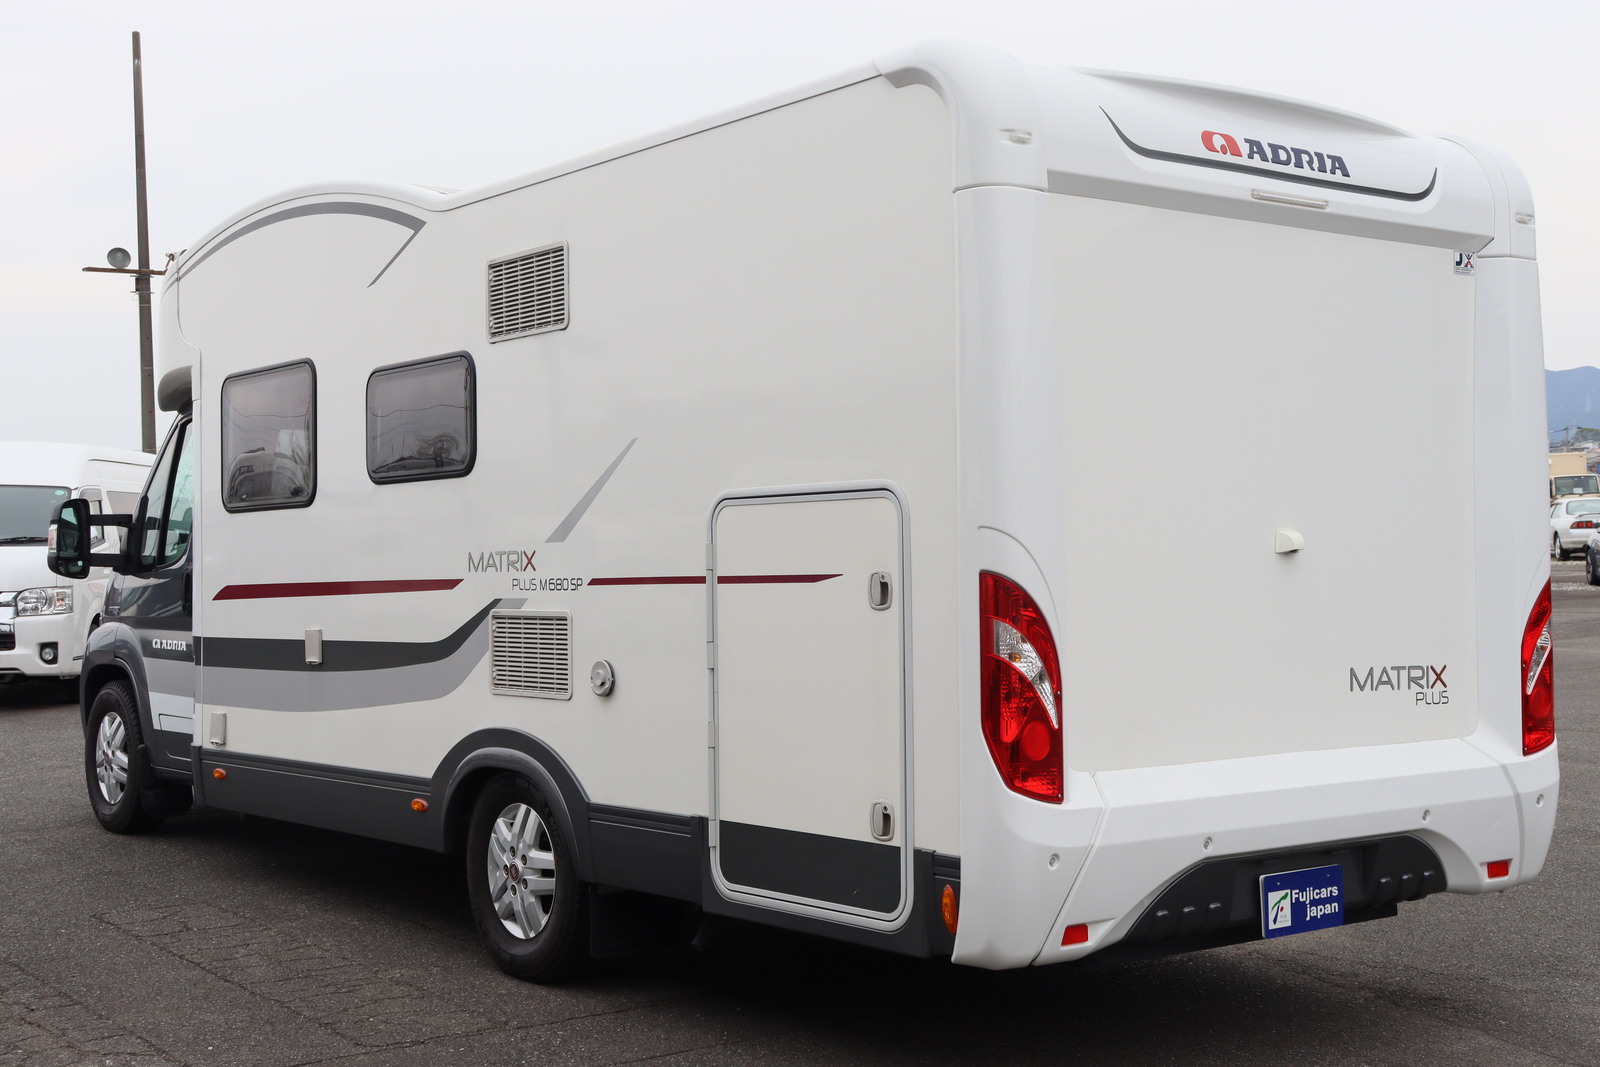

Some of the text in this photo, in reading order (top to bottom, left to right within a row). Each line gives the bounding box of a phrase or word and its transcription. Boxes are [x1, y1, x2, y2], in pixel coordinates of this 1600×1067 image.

[1244, 138, 1350, 178] ADRIA
[467, 550, 536, 572] MATRIX
[512, 578, 537, 591] PLUS
[161, 640, 187, 651] ADRIA
[1349, 664, 1447, 692] MATRIX
[1415, 690, 1449, 706] PLUS
[1291, 886, 1339, 904] Fujicars
[1306, 902, 1339, 921] japan
